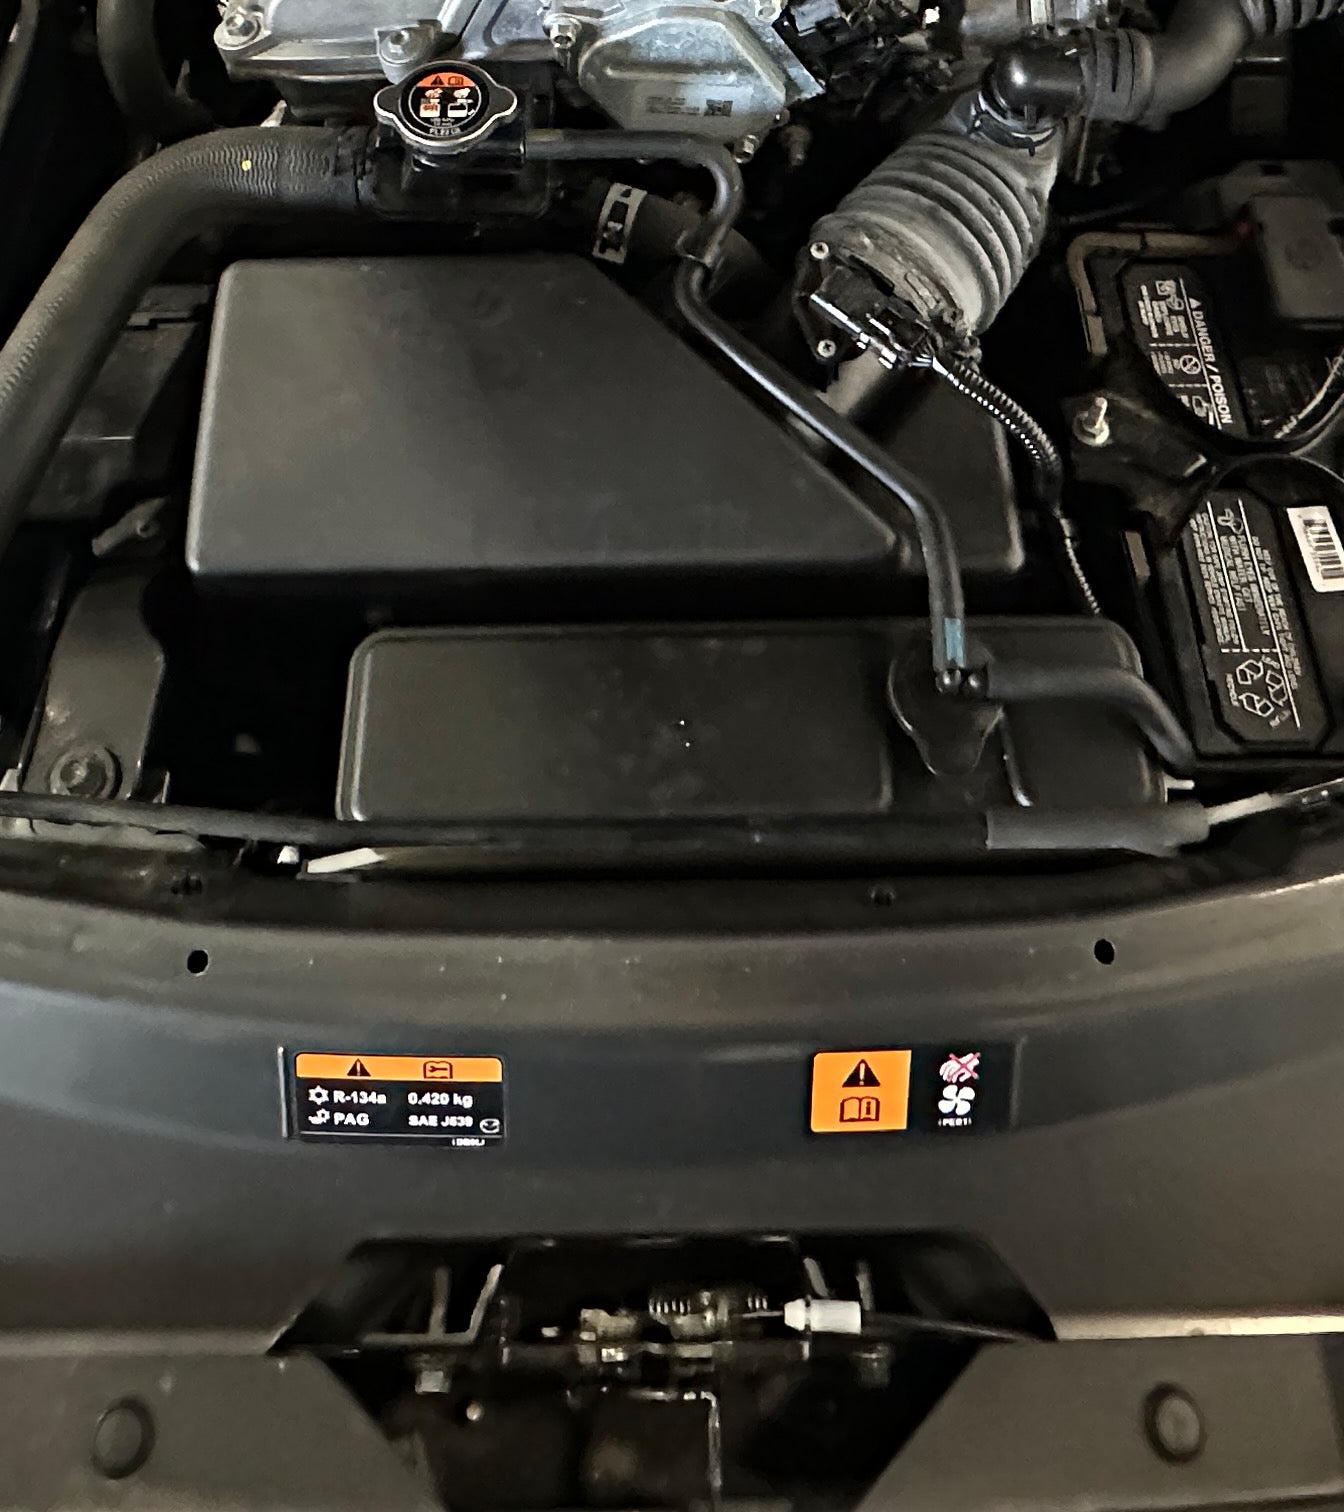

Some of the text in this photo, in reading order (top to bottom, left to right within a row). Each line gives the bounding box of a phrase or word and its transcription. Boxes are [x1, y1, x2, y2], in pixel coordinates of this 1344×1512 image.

[1192, 311, 1216, 362] DANGER
[1209, 374, 1234, 424] POISON
[333, 1091, 473, 1108] R-134a 0.420 kg
[333, 1113, 370, 1127] PAG
[408, 1115, 438, 1127] SAE
